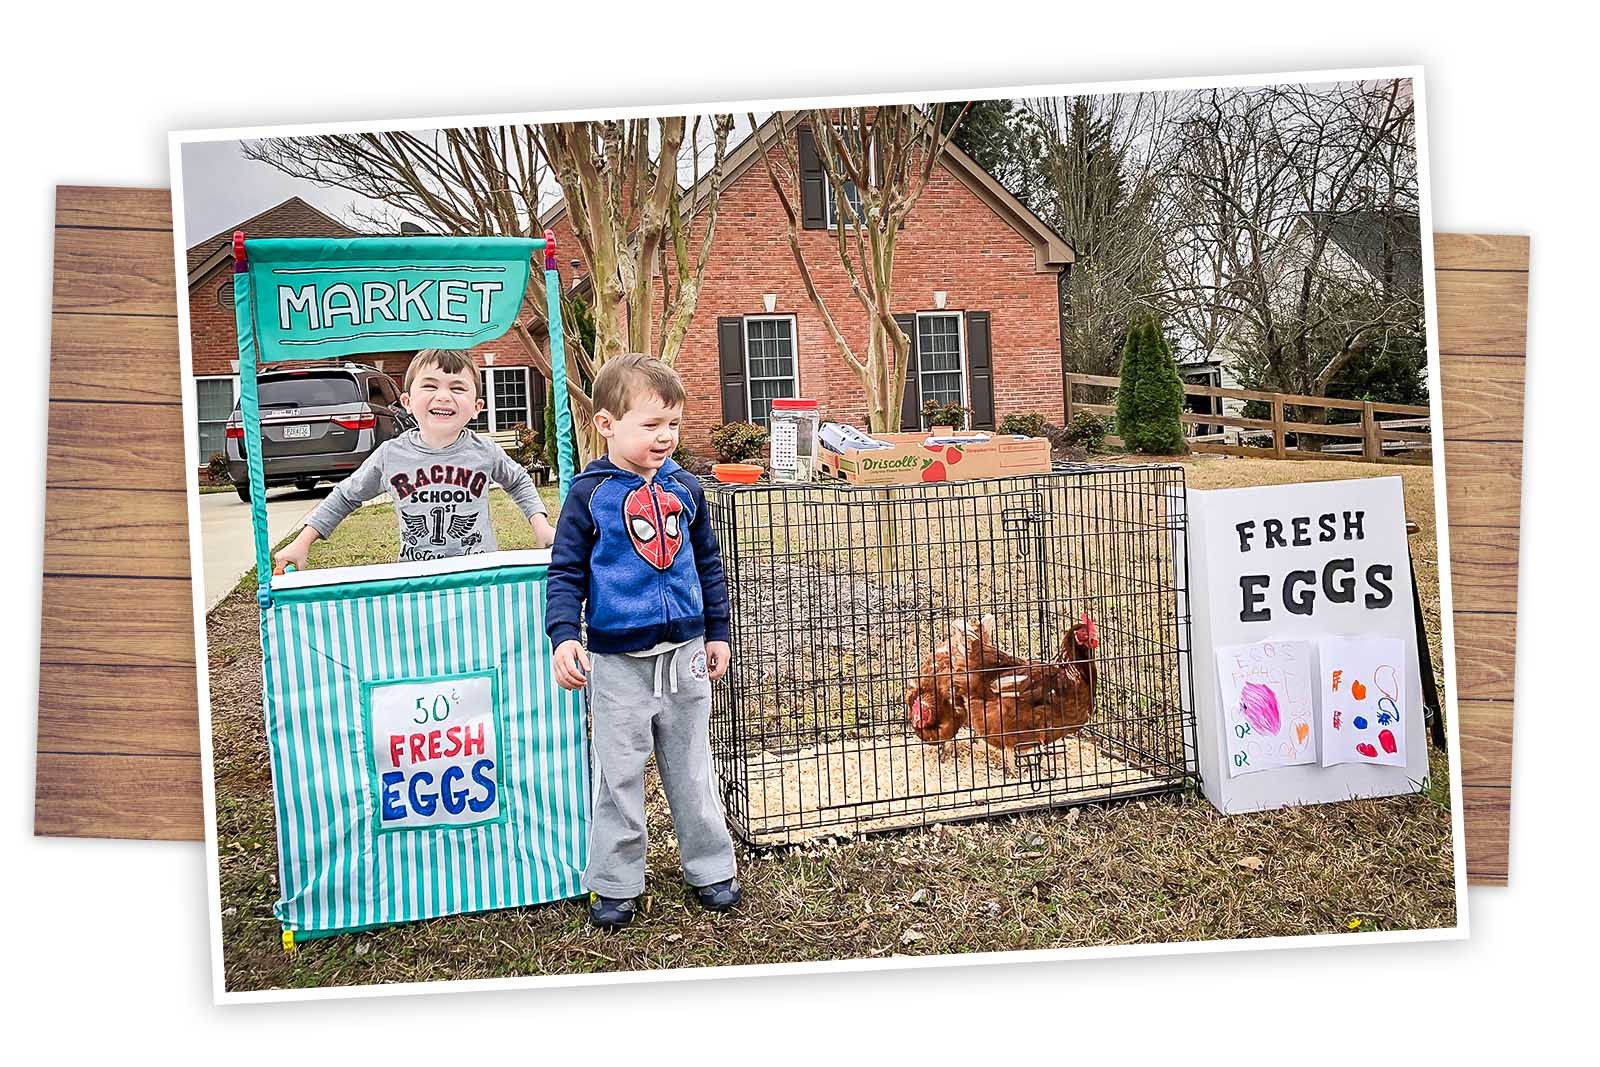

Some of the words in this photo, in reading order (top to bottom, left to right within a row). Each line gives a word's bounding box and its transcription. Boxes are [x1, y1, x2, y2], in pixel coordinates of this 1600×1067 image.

[277, 280, 503, 330] MARKET
[390, 465, 487, 500] RACING
[862, 456, 918, 470] Driscoll's
[411, 490, 473, 503] SCHOOL
[1236, 511, 1365, 552] FRESH
[1239, 558, 1393, 622] EGGS
[390, 722, 485, 768] FRESH
[382, 758, 496, 821] EGGS
